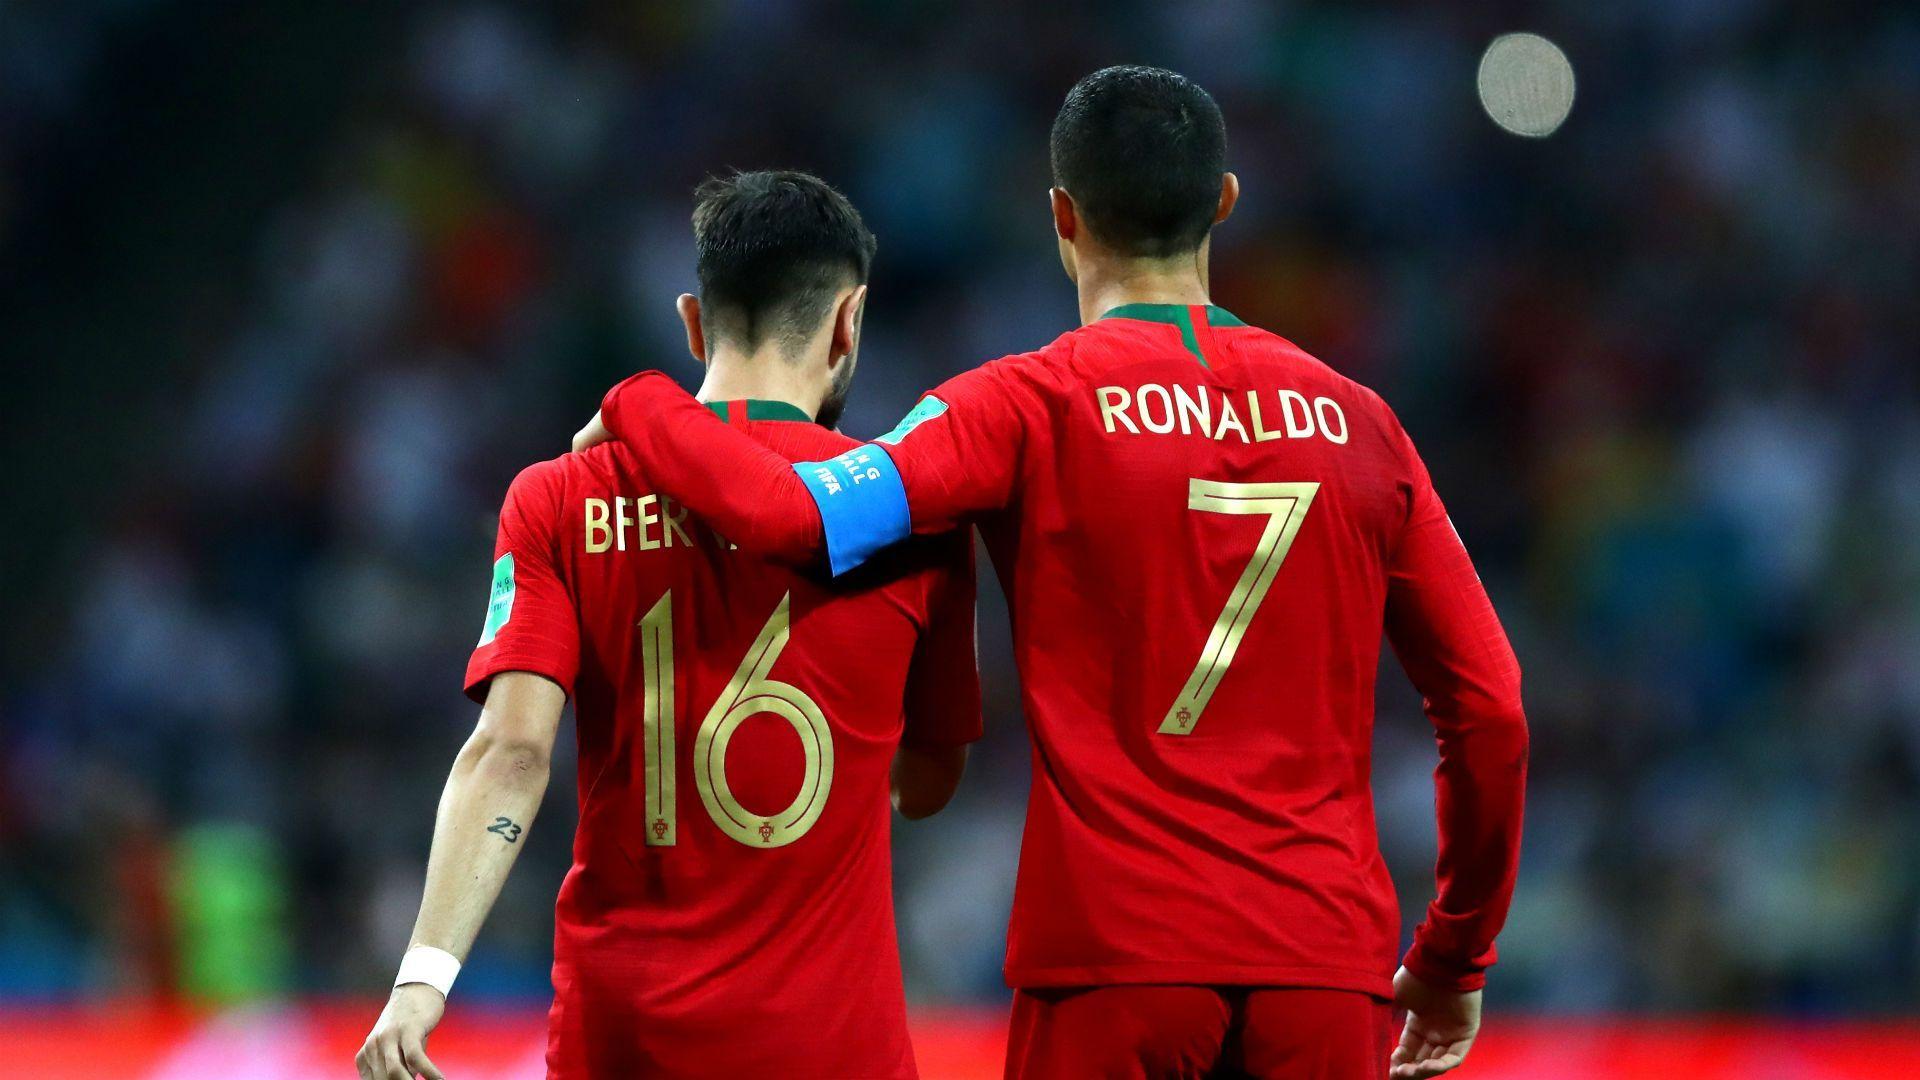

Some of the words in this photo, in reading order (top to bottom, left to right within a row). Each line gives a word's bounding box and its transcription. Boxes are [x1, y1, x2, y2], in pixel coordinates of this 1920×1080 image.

[1096, 384, 1349, 444] RONALDO
[1157, 478, 1321, 735] 7
[638, 588, 834, 848] 16
[487, 817, 521, 843] 23
